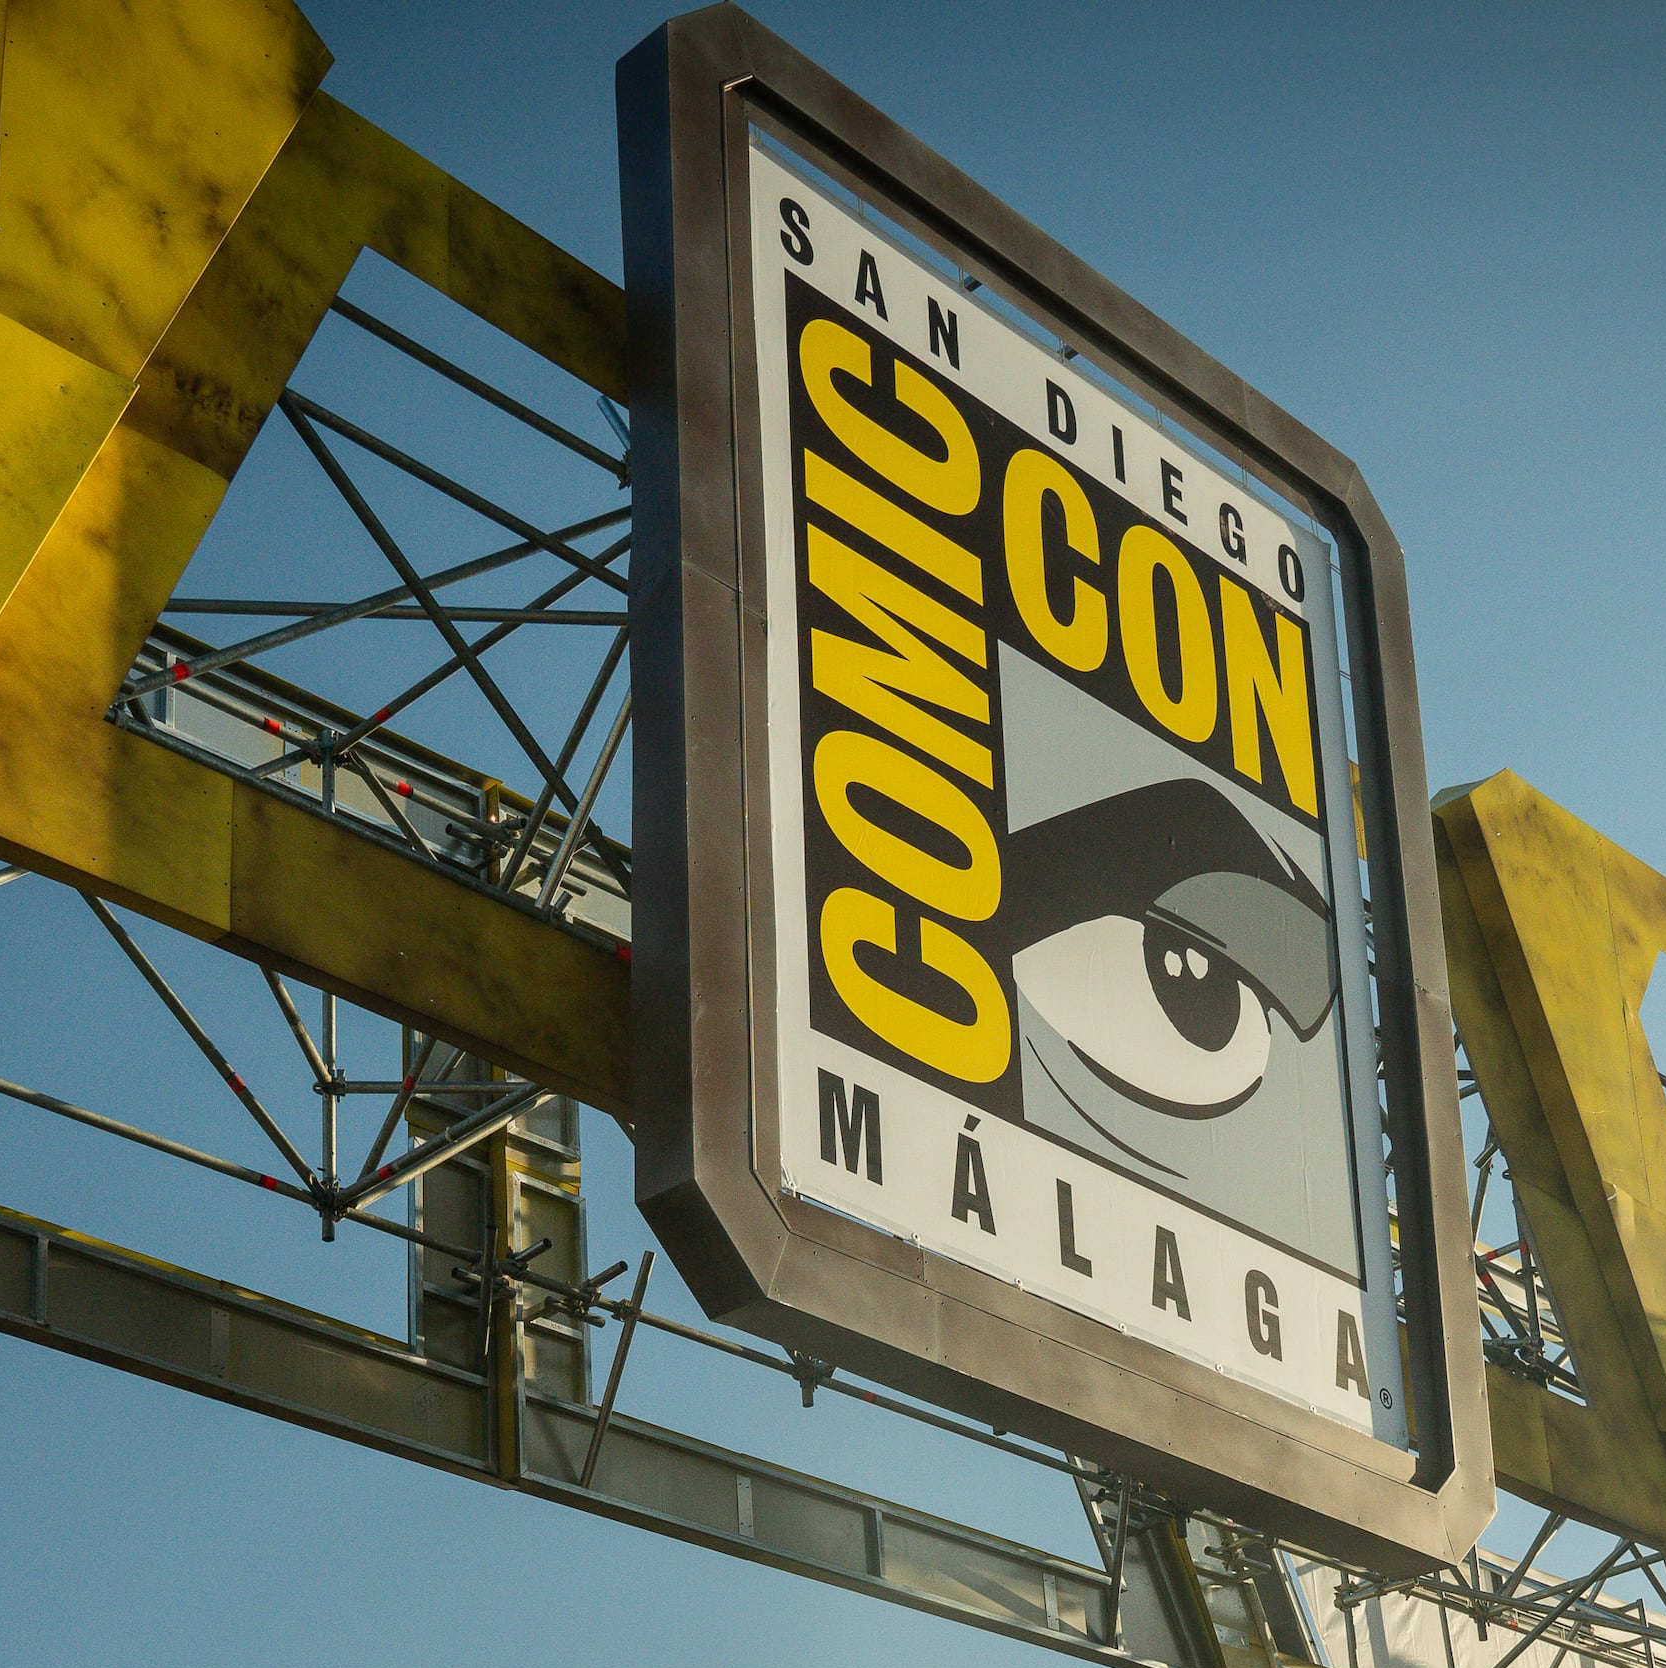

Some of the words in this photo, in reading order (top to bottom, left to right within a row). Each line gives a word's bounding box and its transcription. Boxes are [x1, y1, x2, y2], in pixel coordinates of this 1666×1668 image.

[779, 197, 961, 371] SAN
[1047, 378, 1305, 604] DIEGO
[798, 318, 1012, 1084] COMIC
[1002, 449, 1320, 818] CON
[817, 1066, 1371, 1400] MÁLAGA
